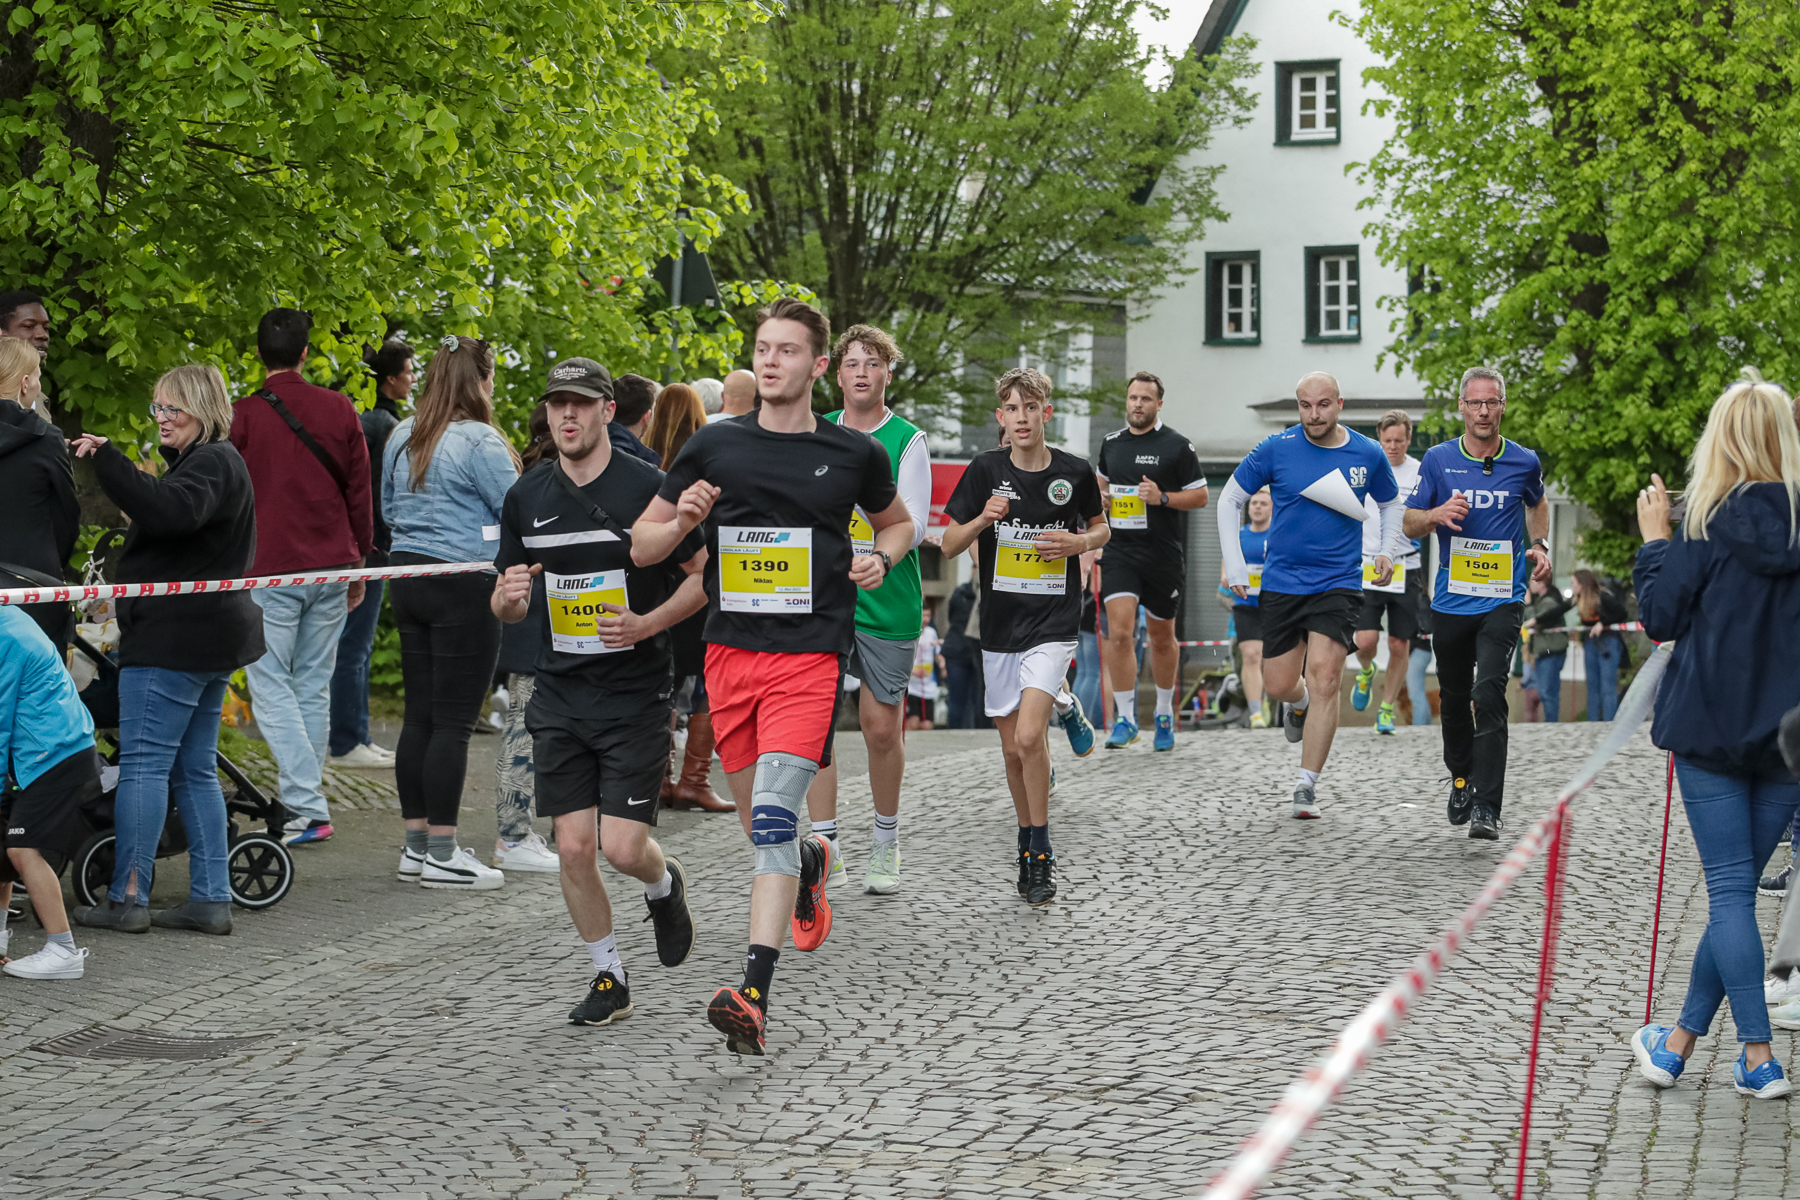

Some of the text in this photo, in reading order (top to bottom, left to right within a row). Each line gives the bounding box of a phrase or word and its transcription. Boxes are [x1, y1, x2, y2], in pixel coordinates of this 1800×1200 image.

[1452, 489, 1509, 509] MDT
[737, 531, 776, 543] LANG
[1014, 531, 1043, 541] LAN
[1464, 541, 1491, 551] LANG
[1014, 553, 1052, 563] 177
[739, 560, 789, 572] 1390
[1465, 560, 1499, 570] 1504
[557, 578, 590, 589] LANG
[561, 603, 606, 616] 1400
